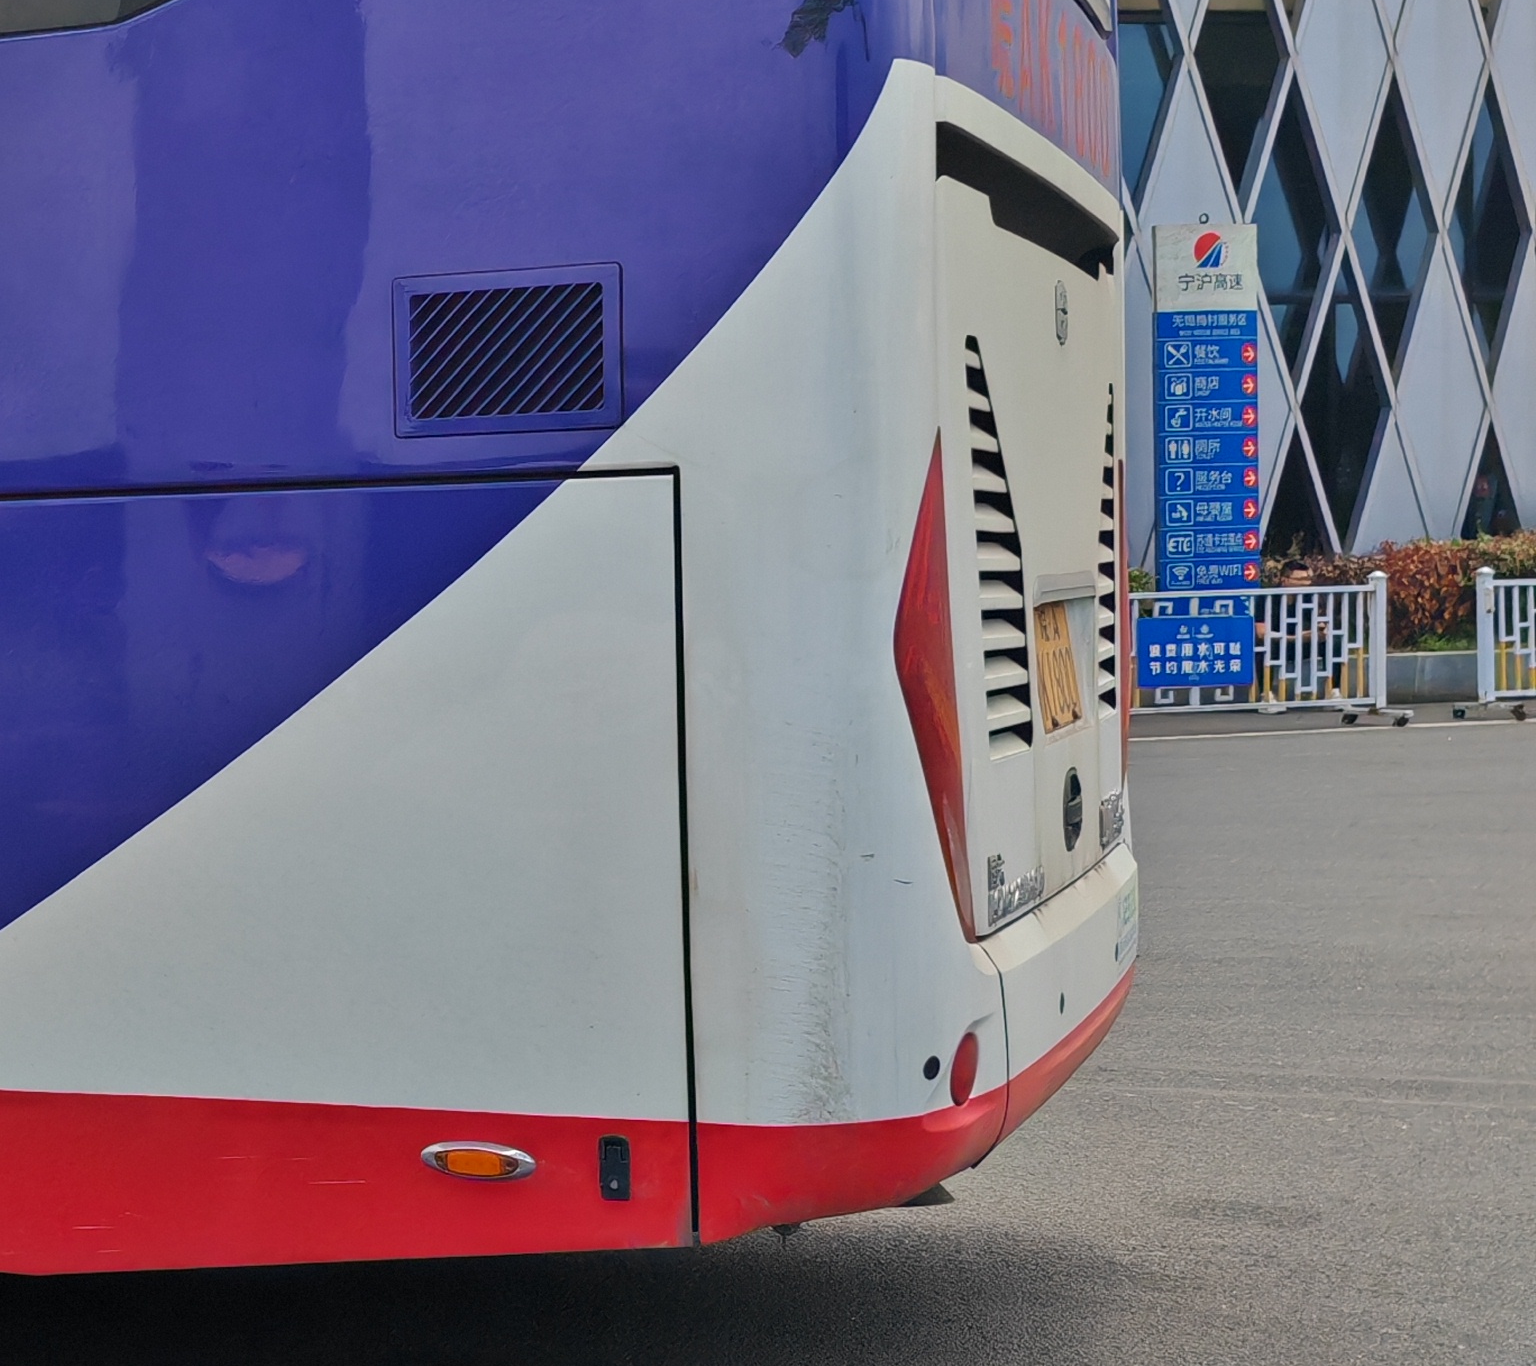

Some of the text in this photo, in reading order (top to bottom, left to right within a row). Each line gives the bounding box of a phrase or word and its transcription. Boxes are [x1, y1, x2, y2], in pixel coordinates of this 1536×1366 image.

[1178, 273, 1244, 291] 宁沪高速
[1194, 344, 1220, 358] 餐饮
[1194, 376, 1220, 389] 商店
[1194, 407, 1232, 421] 开水间
[1195, 470, 1232, 484] 服务台
[1168, 536, 1192, 552] ETC
[1148, 658, 1242, 675] 节约用水光荣
